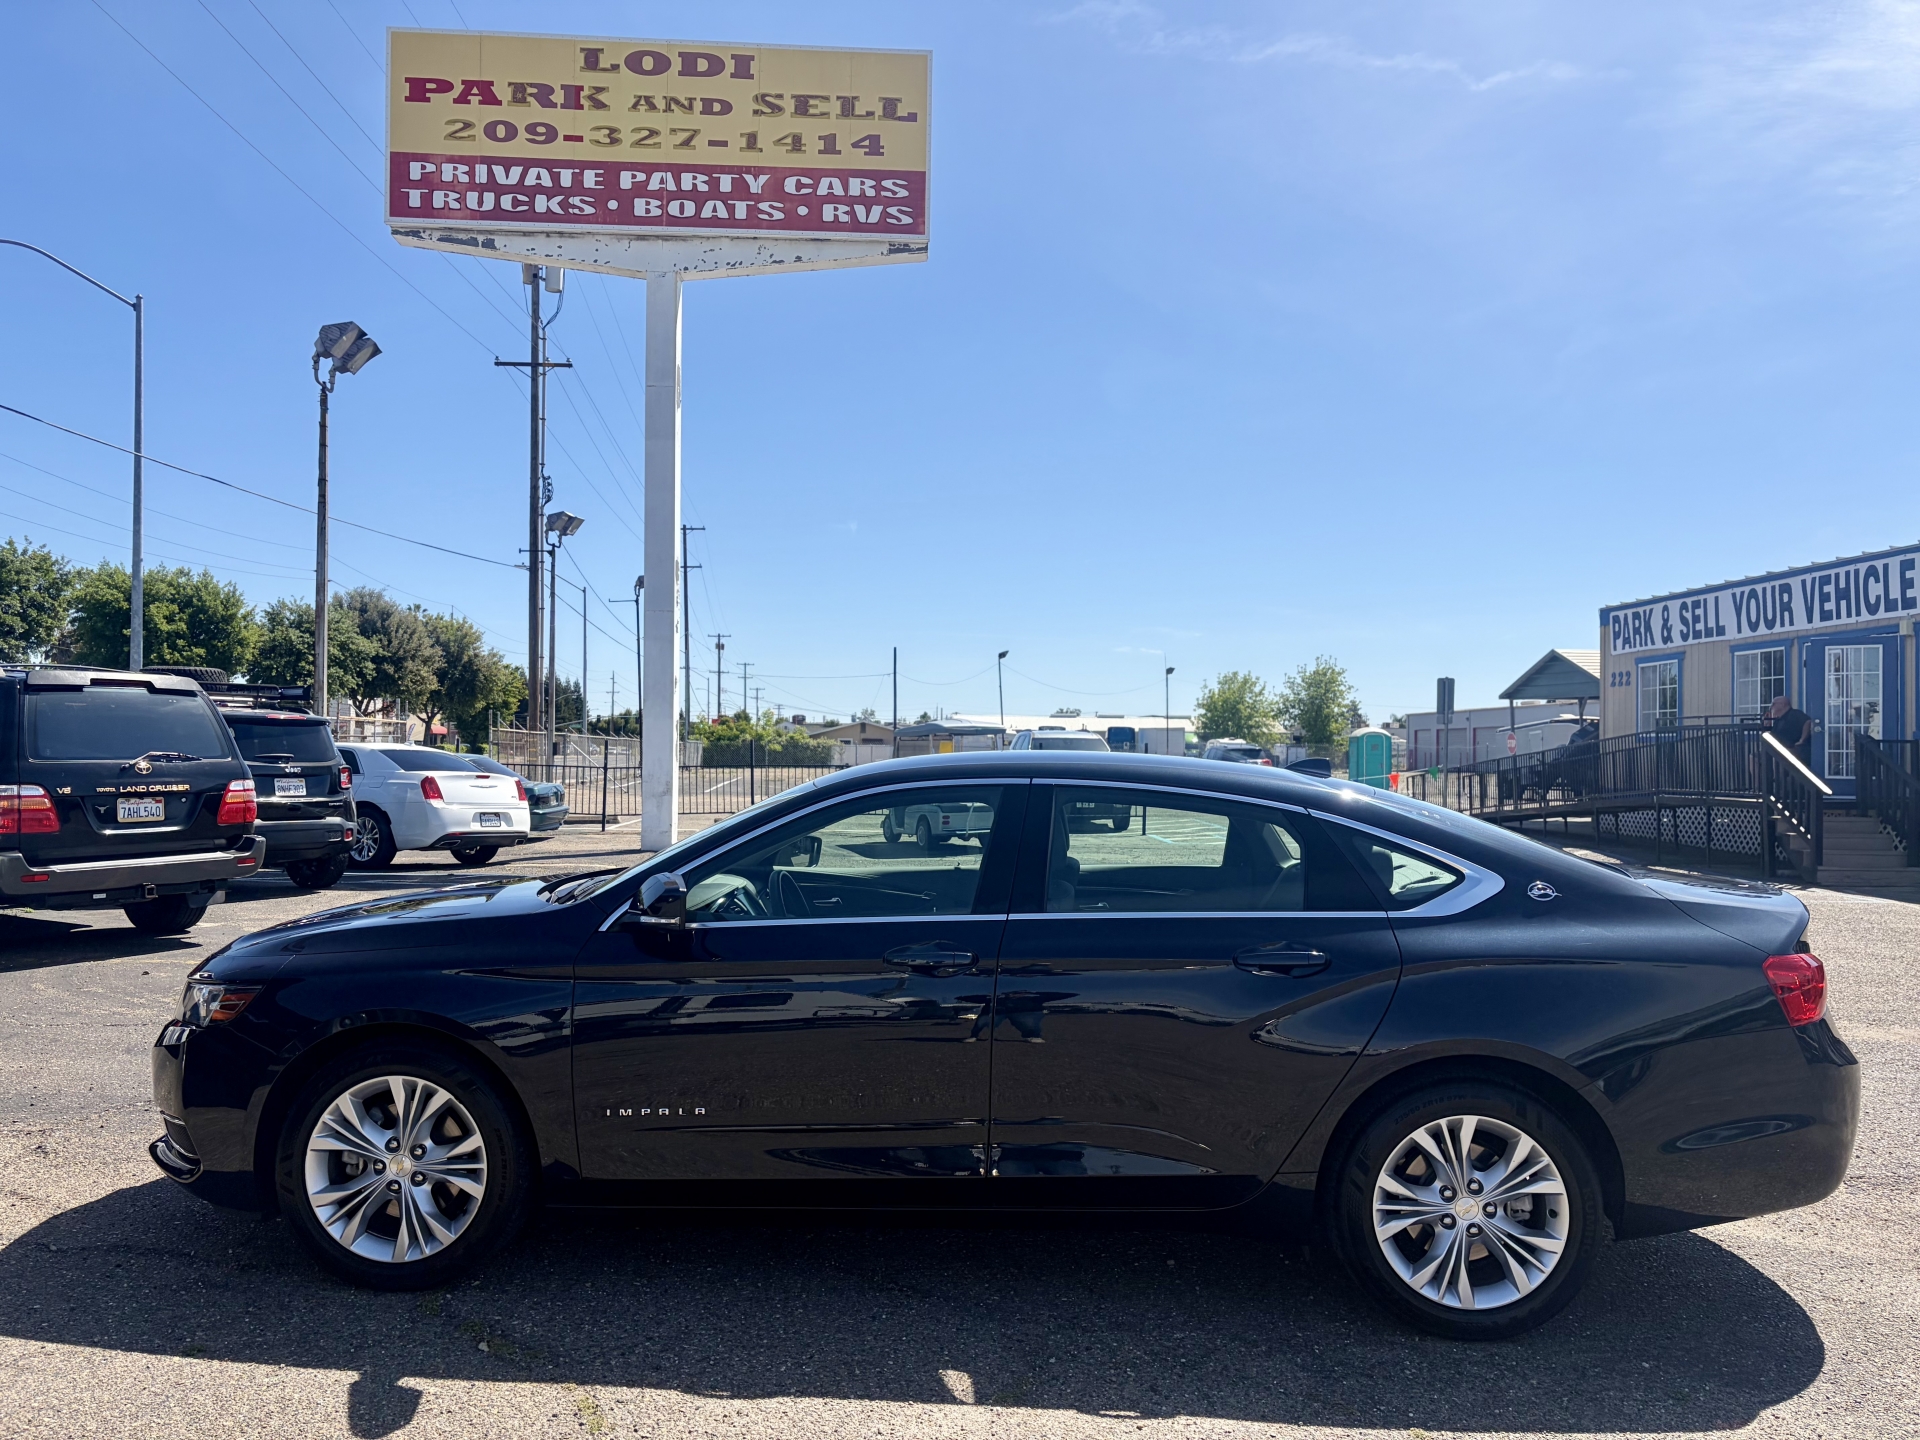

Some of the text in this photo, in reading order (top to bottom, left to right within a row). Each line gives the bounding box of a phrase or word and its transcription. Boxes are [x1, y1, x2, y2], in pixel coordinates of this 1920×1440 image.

[579, 46, 755, 81] LODI
[404, 76, 918, 123] PARK AND SELL
[443, 118, 886, 157] 209-327-1414
[409, 161, 910, 199] PRIVATE PARTY CARS
[400, 188, 914, 225] TRUCKS BOATS RVS
[1612, 557, 1918, 652] PARK & SELL YOUR VEHICLE
[1610, 670, 1631, 687] 222
[56, 786, 72, 794] V8
[120, 785, 147, 793] LAND
[148, 784, 191, 792] CRUISER
[121, 805, 161, 819] 7AHL540
[606, 1107, 706, 1117] IMPALA
